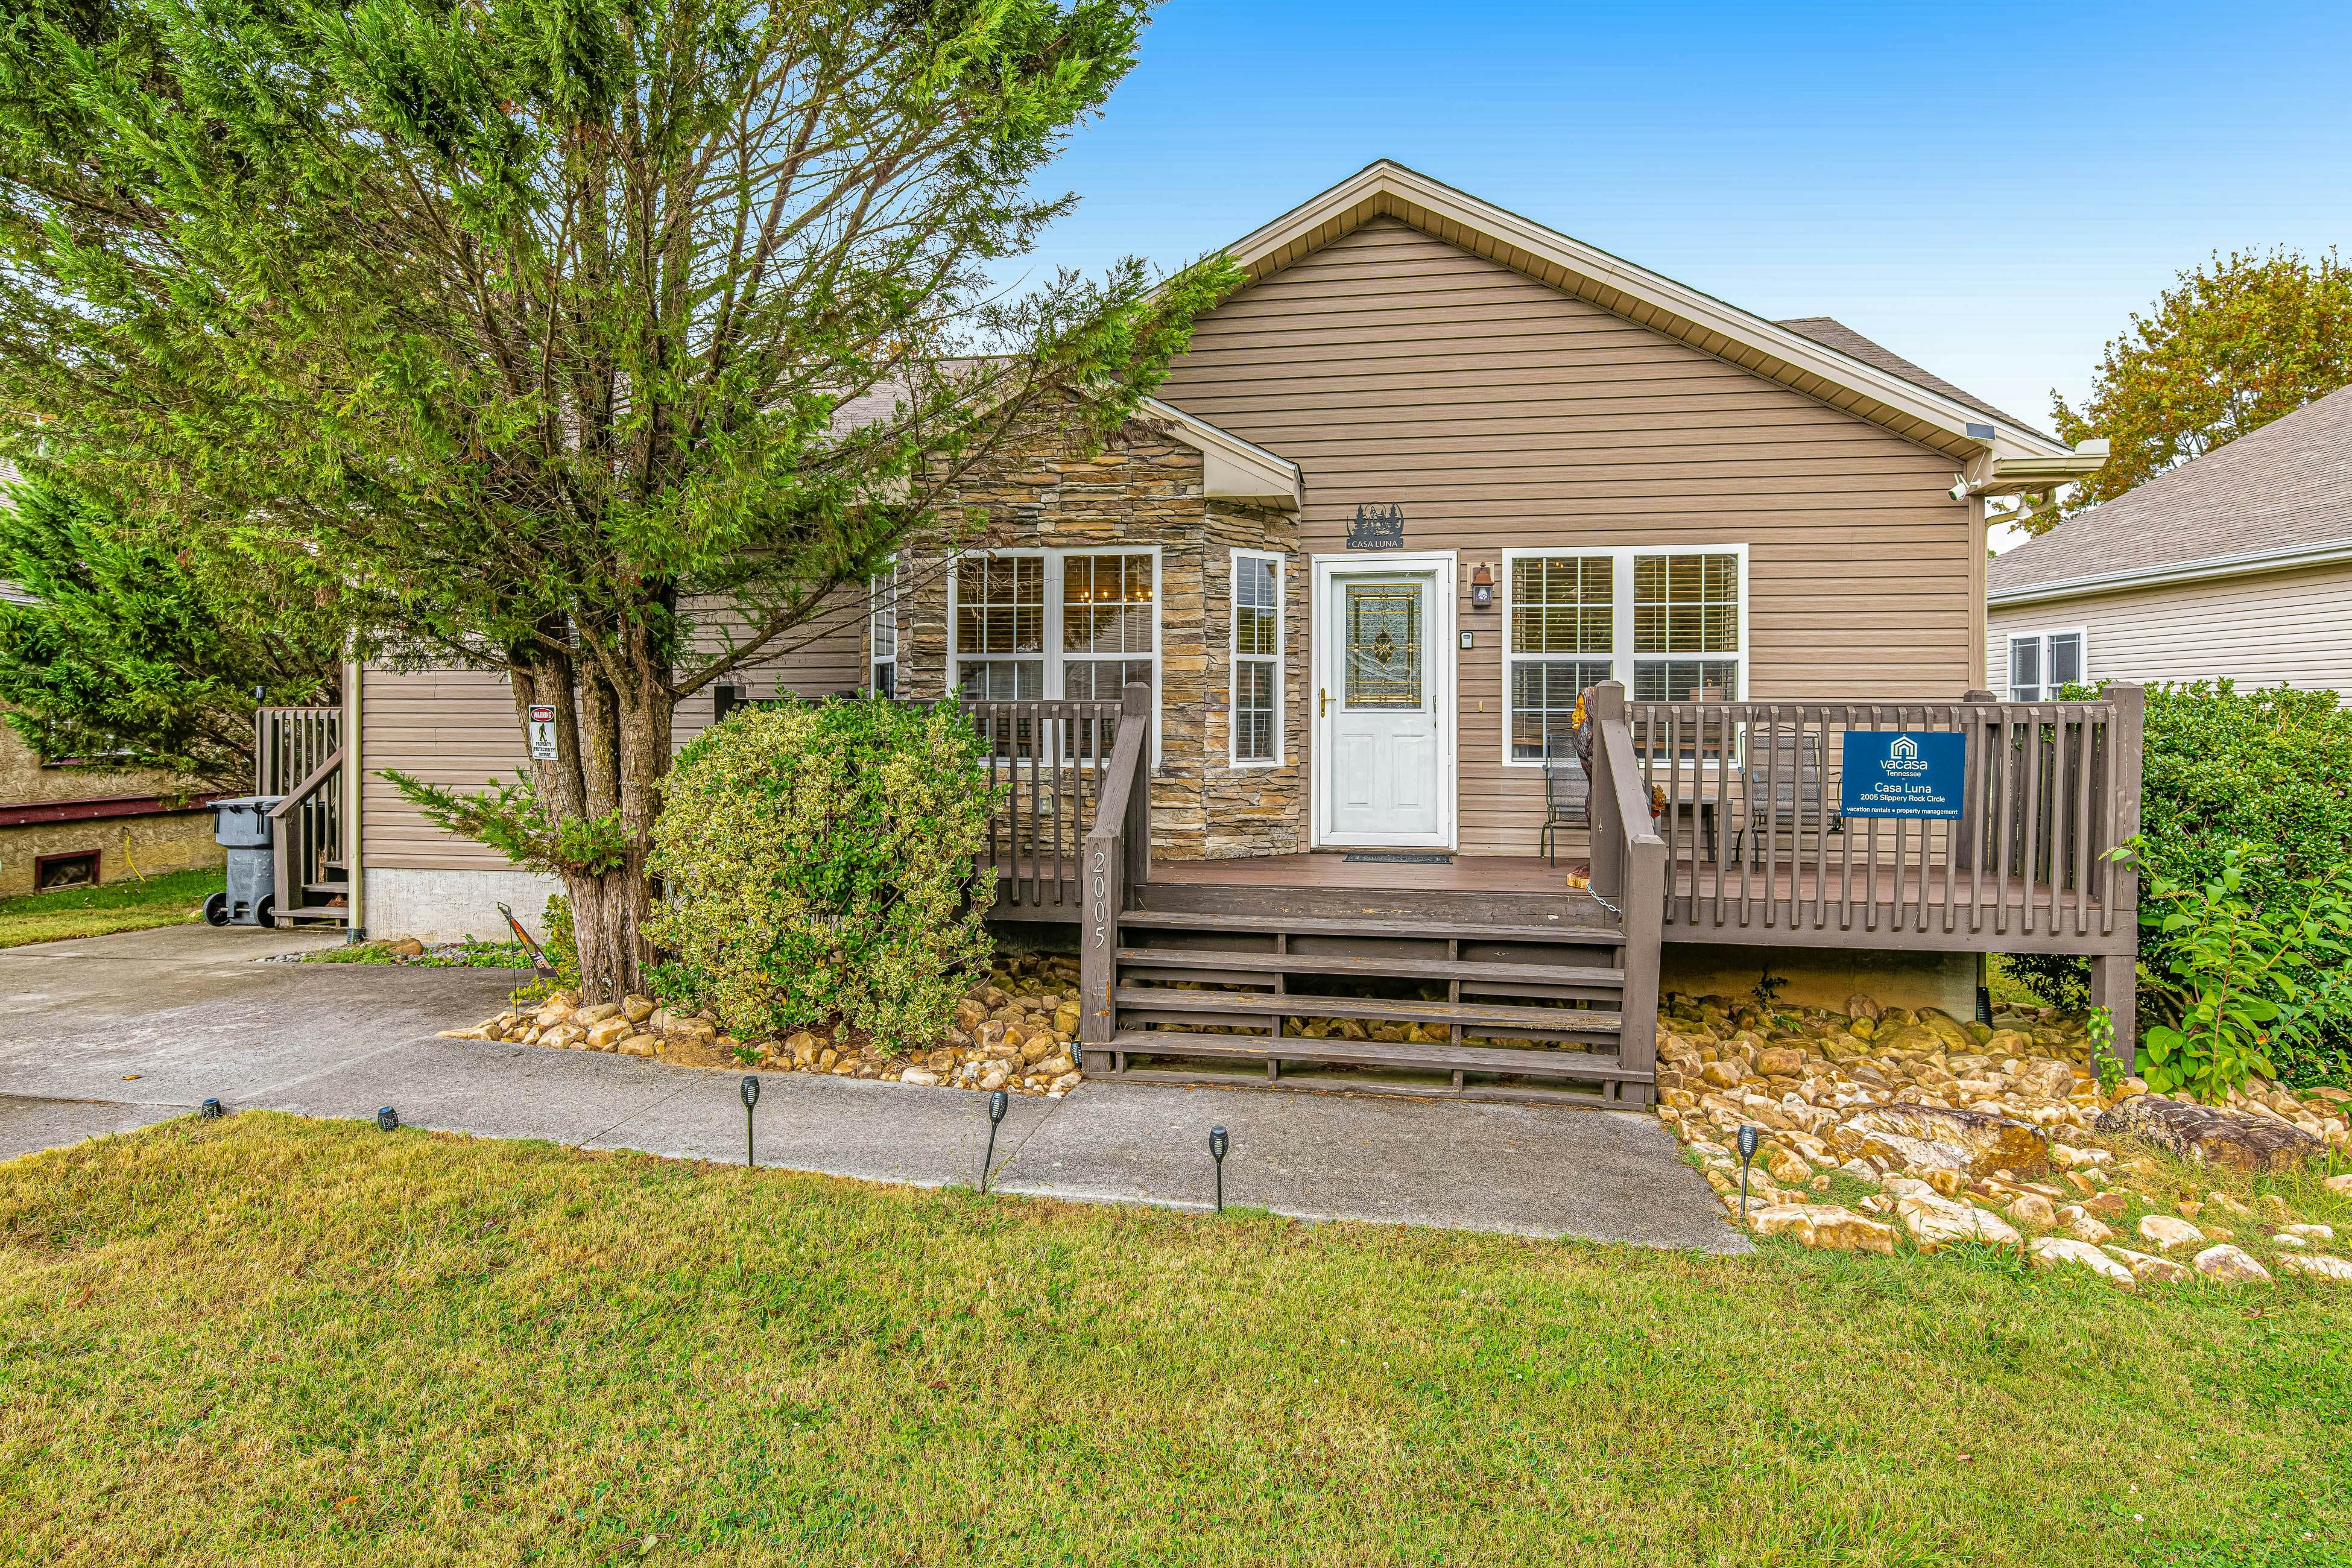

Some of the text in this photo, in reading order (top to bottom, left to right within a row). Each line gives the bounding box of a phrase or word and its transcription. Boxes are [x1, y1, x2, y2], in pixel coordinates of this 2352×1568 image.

[1880, 759, 1927, 770] vacasa
[1874, 782, 1932, 794] Casa Luna
[1880, 794, 1908, 803] Slippery
[1093, 851, 1105, 949] 2005
